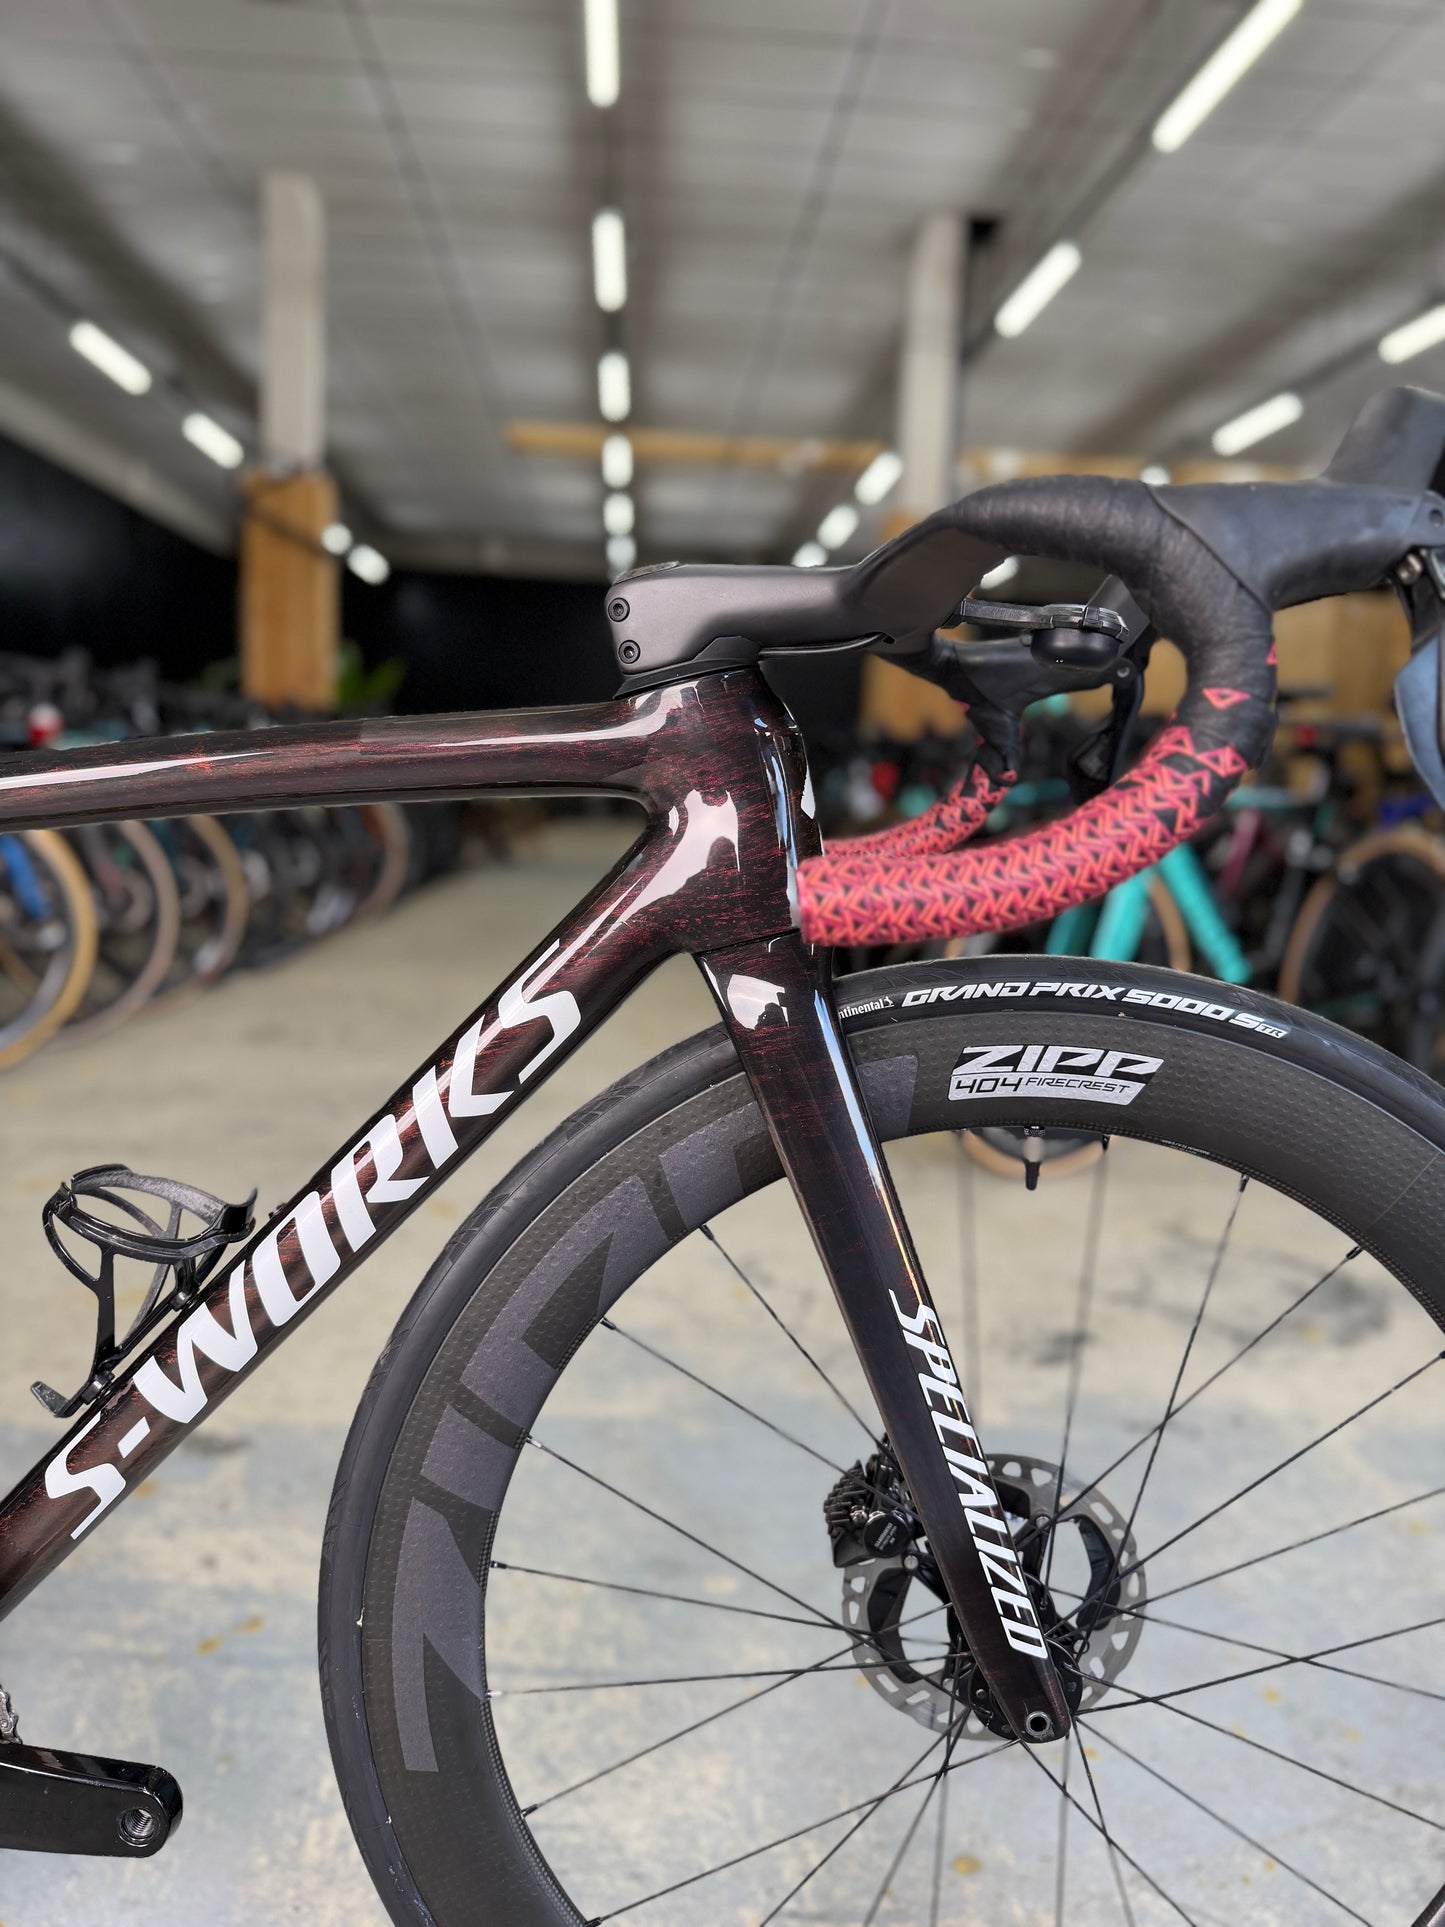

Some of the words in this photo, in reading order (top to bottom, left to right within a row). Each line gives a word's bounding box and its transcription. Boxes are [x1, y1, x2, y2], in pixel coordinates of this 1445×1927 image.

[838, 998, 885, 1019] ntinental
[902, 982, 1031, 1007] GRAND
[1029, 982, 1126, 1000] PRIX
[1121, 988, 1236, 1021] 5000
[952, 1045, 1165, 1078] ZIPP
[955, 1077, 1023, 1094] 404
[1025, 1076, 1131, 1094] FIRECREST
[45, 939, 582, 1540] S-WORKS
[889, 1288, 1049, 1660] SPECIALIZED
